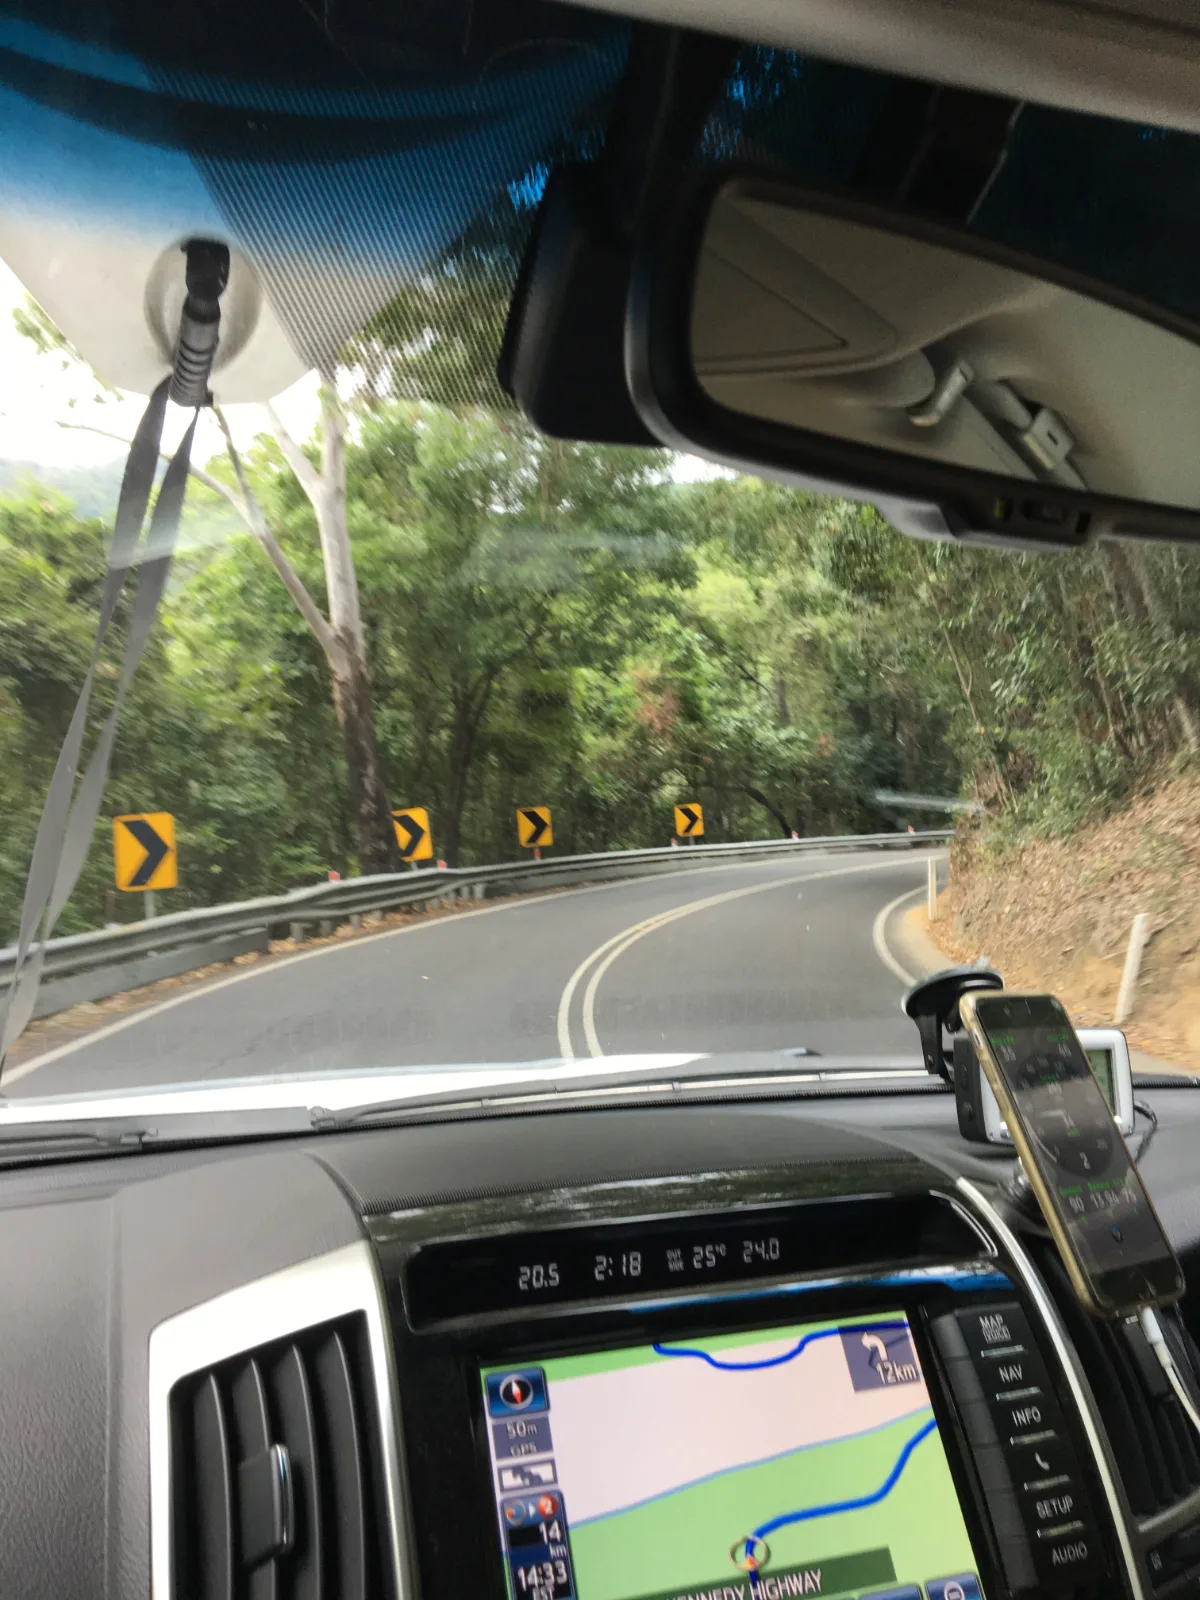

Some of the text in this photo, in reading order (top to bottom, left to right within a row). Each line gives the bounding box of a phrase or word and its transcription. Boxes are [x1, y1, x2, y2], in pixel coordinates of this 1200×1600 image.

[743, 1237, 780, 1263] 24.0
[518, 1251, 642, 1290] 20.5 2:18
[979, 1313, 1004, 1332] MAP
[876, 1360, 917, 1384] 12km
[999, 1363, 1023, 1383] NAV
[1011, 1405, 1042, 1428] INFO
[1036, 1494, 1073, 1519] SETUP
[539, 1519, 562, 1545] 14
[549, 1543, 567, 1559] km
[1052, 1541, 1088, 1566] AUDIO
[518, 1560, 567, 1592] 14:33
[749, 1568, 821, 1600] HIGHWAY
